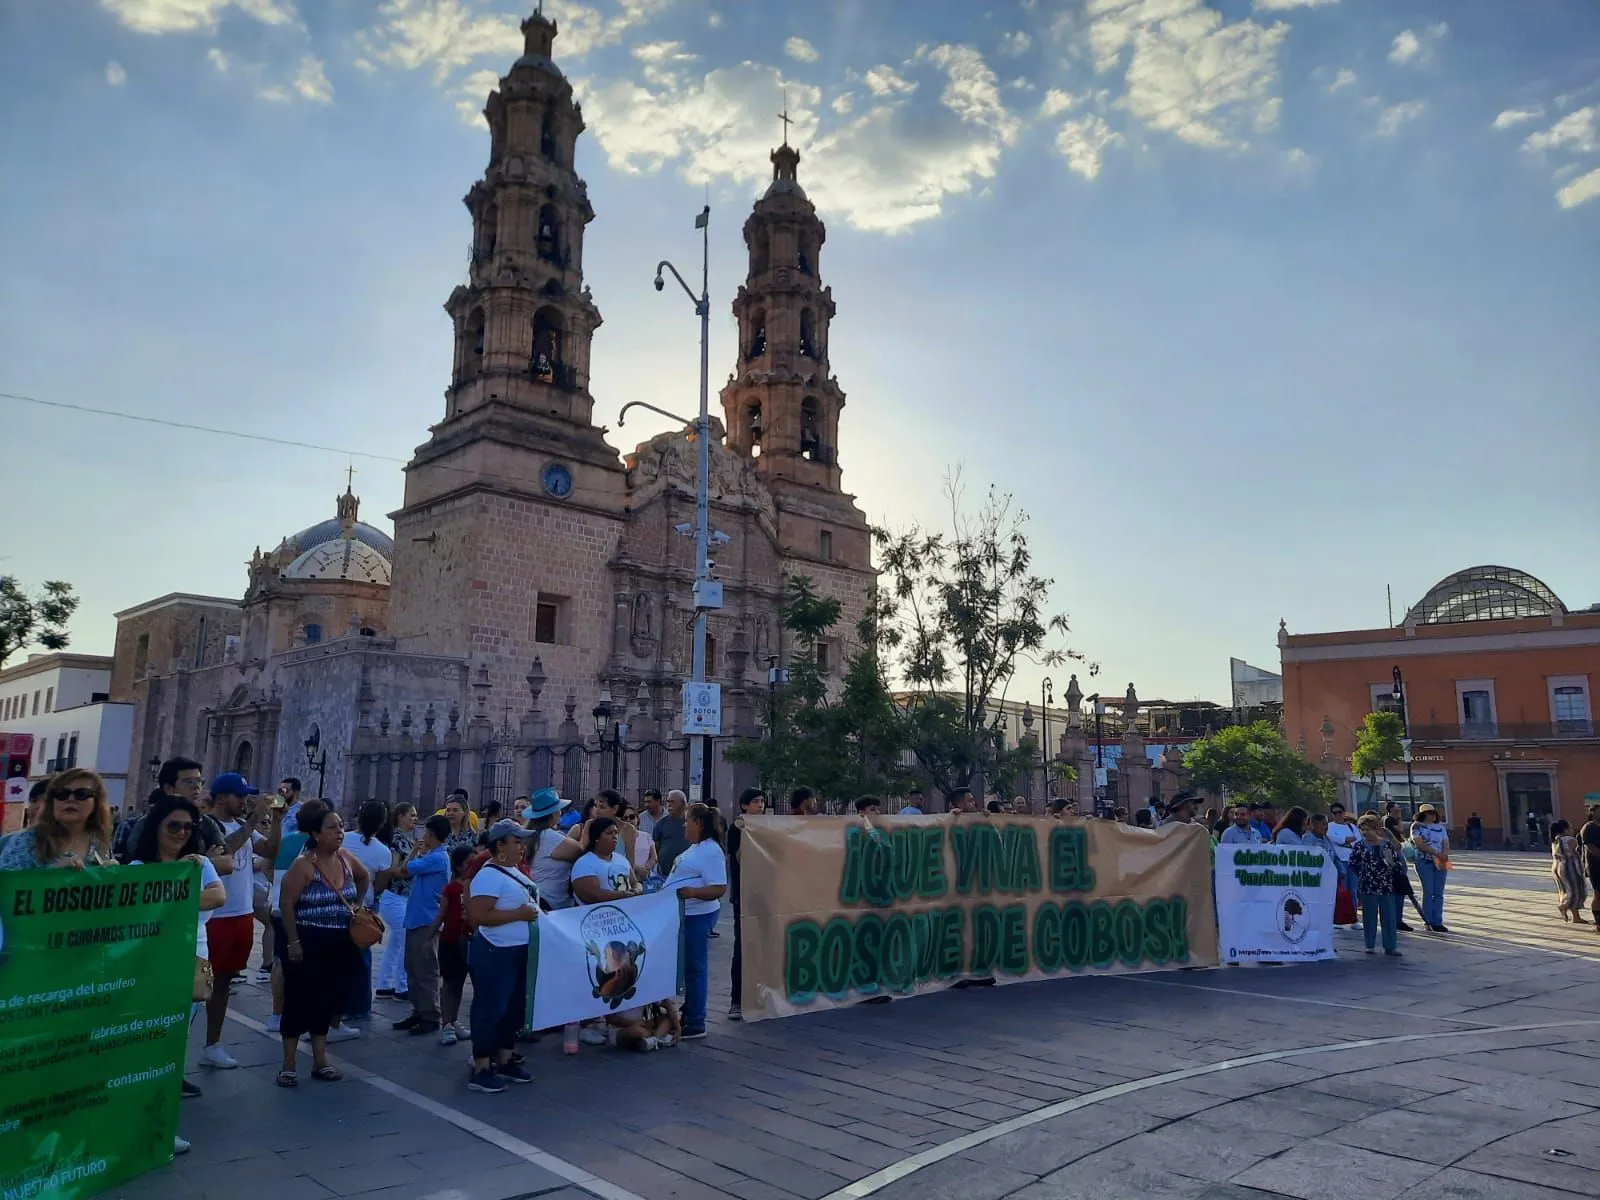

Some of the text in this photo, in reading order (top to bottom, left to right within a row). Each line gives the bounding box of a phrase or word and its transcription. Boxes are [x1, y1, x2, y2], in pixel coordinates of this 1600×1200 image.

[951, 824, 1043, 894] VIVA
[1048, 826, 1096, 892] EL
[13, 877, 191, 916] EL BOSQUE DE COBOS
[47, 931, 64, 948] LO
[127, 920, 162, 938] TODOS
[601, 922, 635, 937] PARGA
[785, 896, 1190, 1003] BOSQUE DE COBOS!
[8, 994, 26, 1008] de
[27, 988, 73, 1005] recarga
[75, 981, 95, 997] del
[130, 1018, 143, 1032] de
[4, 1174, 59, 1200] NUESTRO
[60, 1159, 107, 1185] FUTURO
